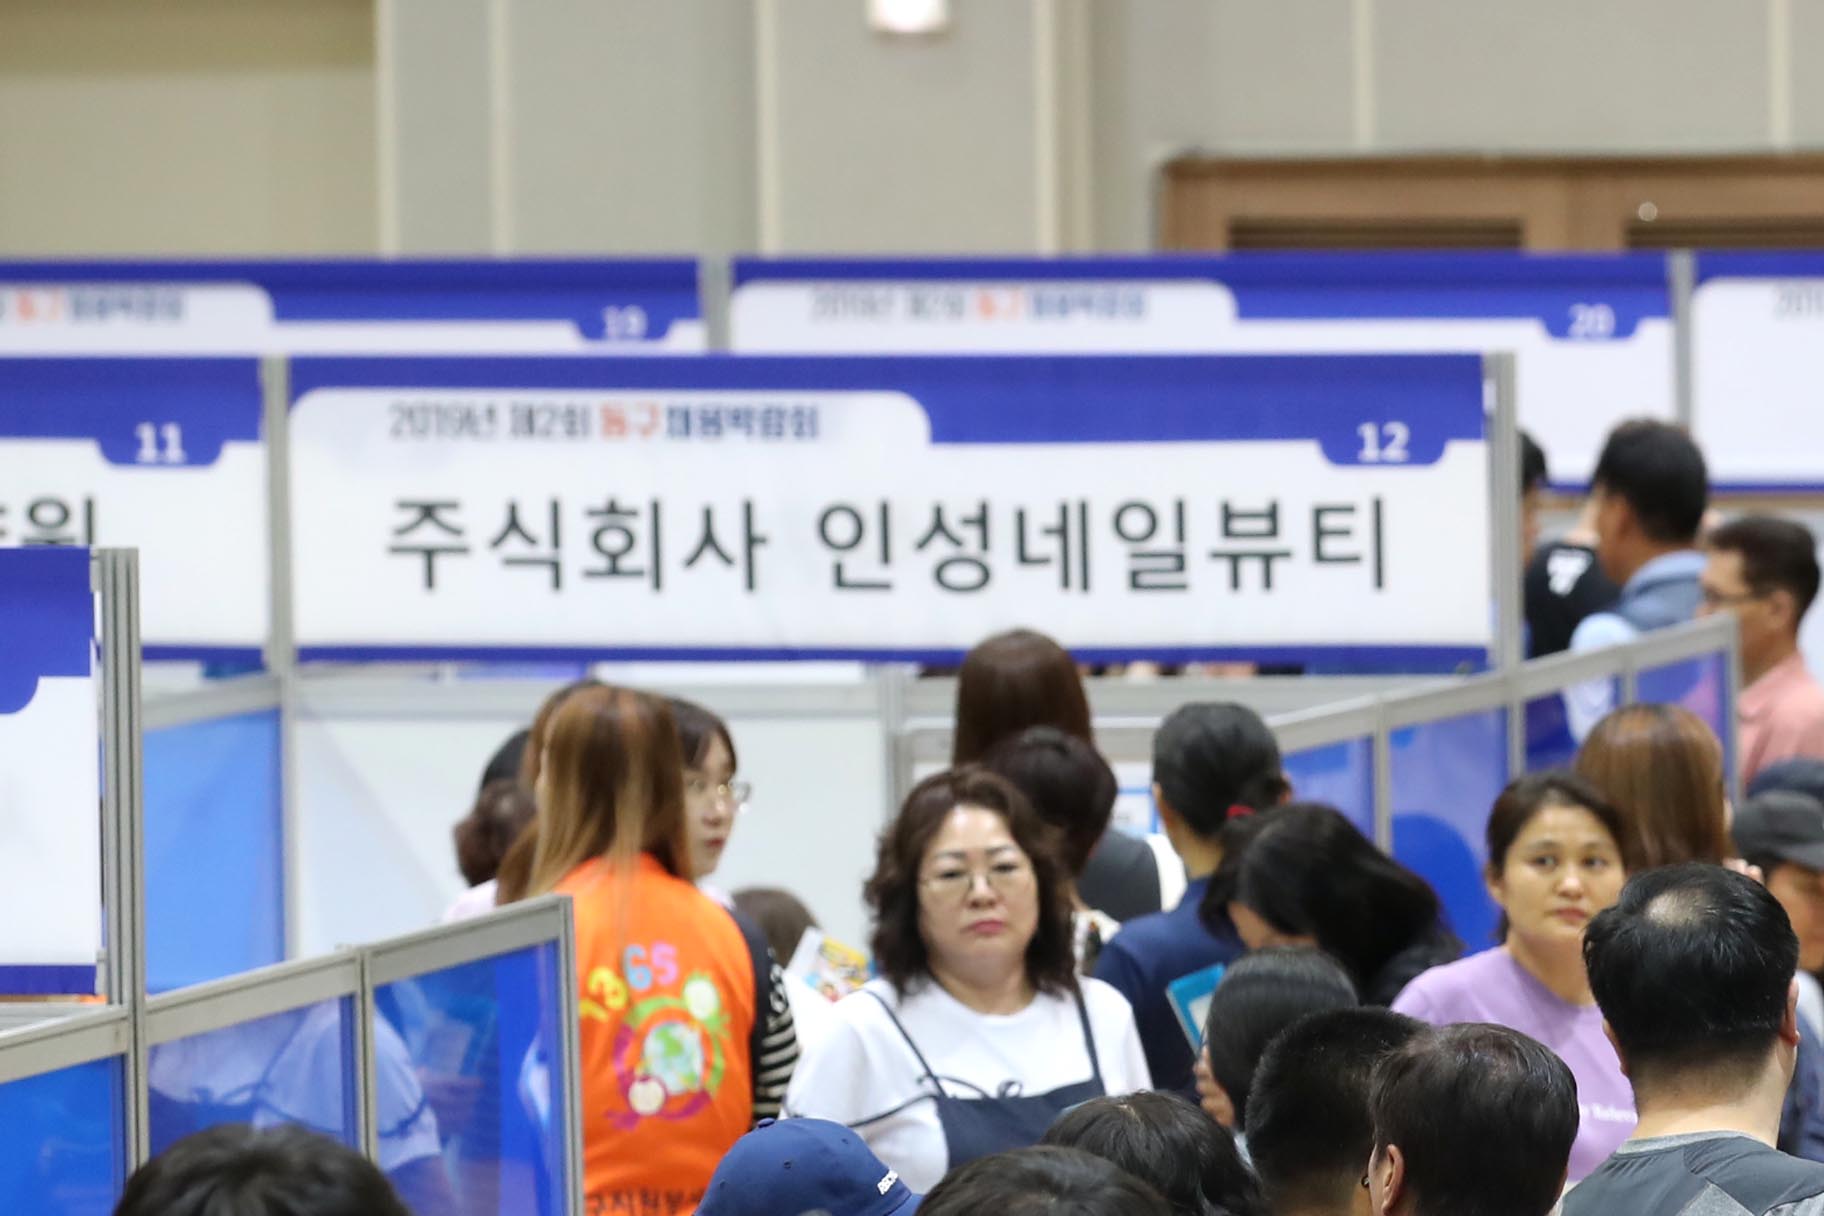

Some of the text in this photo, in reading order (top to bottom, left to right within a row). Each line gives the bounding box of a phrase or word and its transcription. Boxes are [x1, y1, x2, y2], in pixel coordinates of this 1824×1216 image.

[1568, 303, 1615, 338] 20
[135, 421, 187, 464] 11
[1357, 422, 1410, 462] 12
[387, 496, 1387, 593] 주식회사 인성네일뷰티
